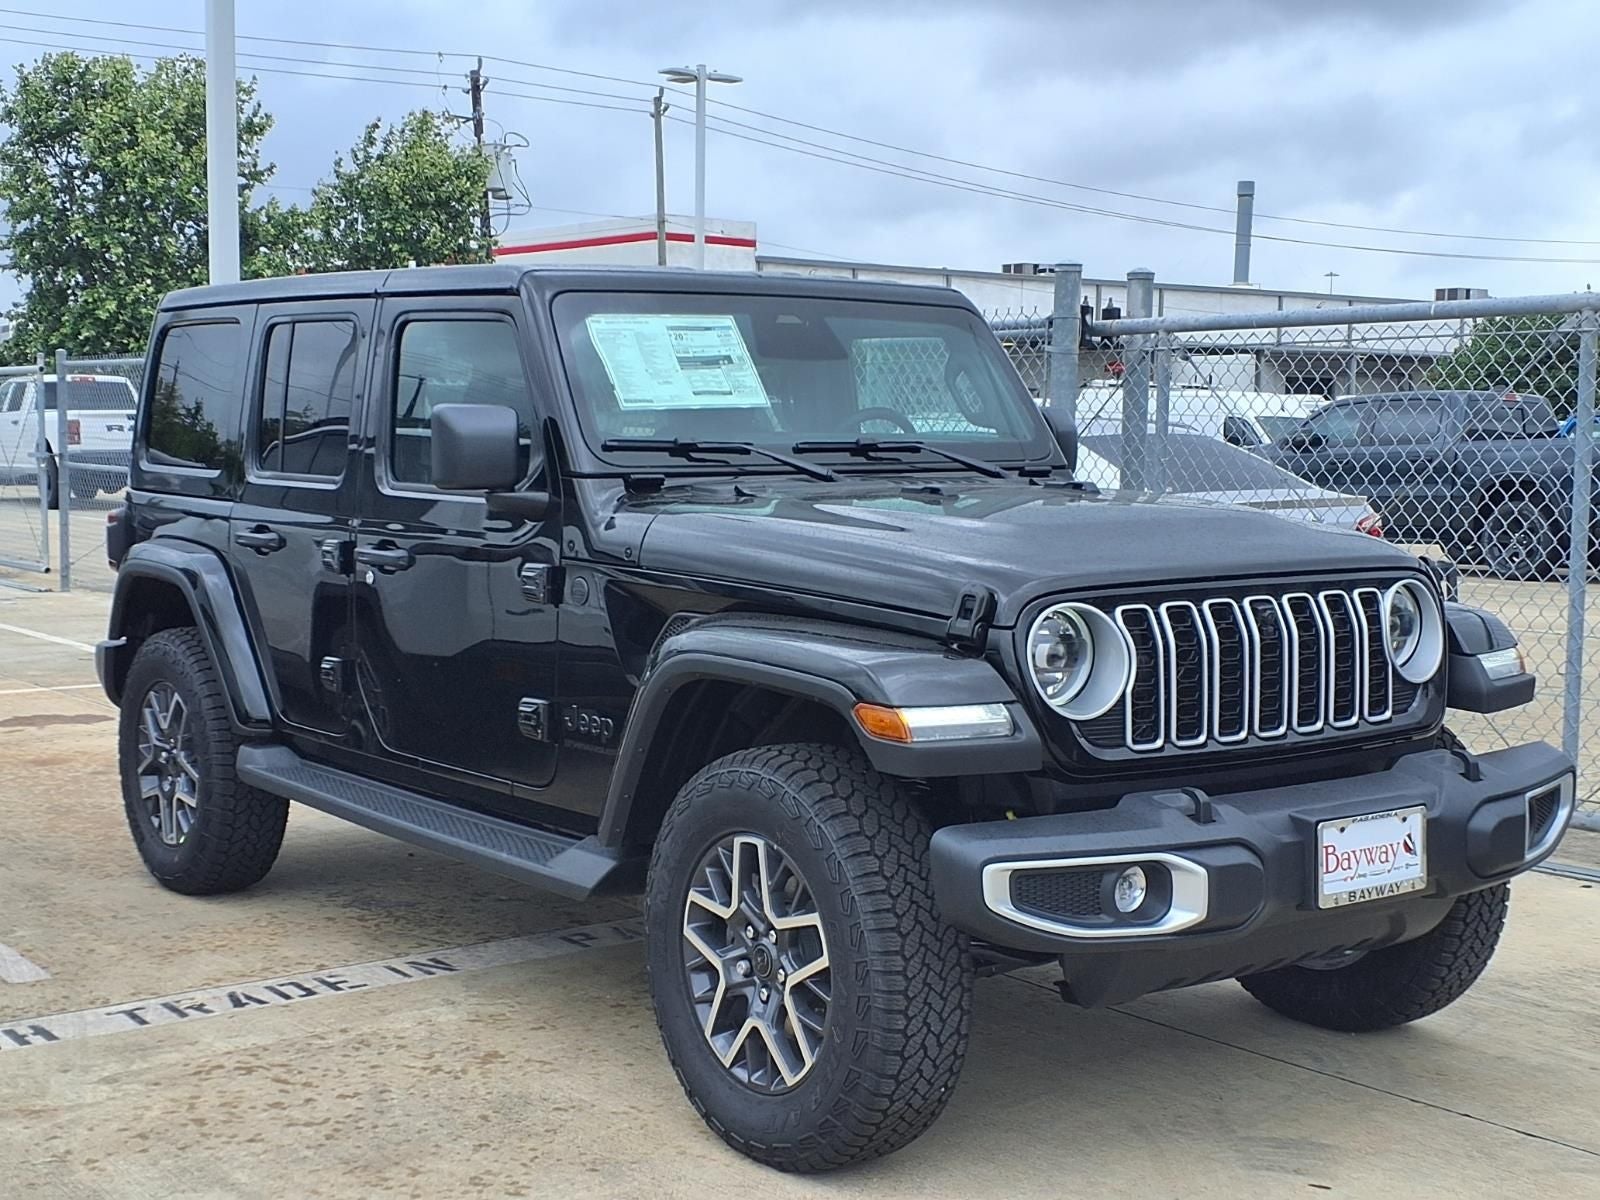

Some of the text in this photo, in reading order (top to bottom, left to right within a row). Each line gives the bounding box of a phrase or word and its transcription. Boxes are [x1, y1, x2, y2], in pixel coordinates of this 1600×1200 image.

[563, 704, 614, 744] Jeep
[1352, 812, 1398, 823] PASADENA
[1323, 842, 1400, 881] Bayway
[1348, 882, 1402, 903] BAYWAY
[0, 1024, 60, 1050] H
[104, 974, 368, 1026] TRADE
[382, 957, 462, 978] IN
